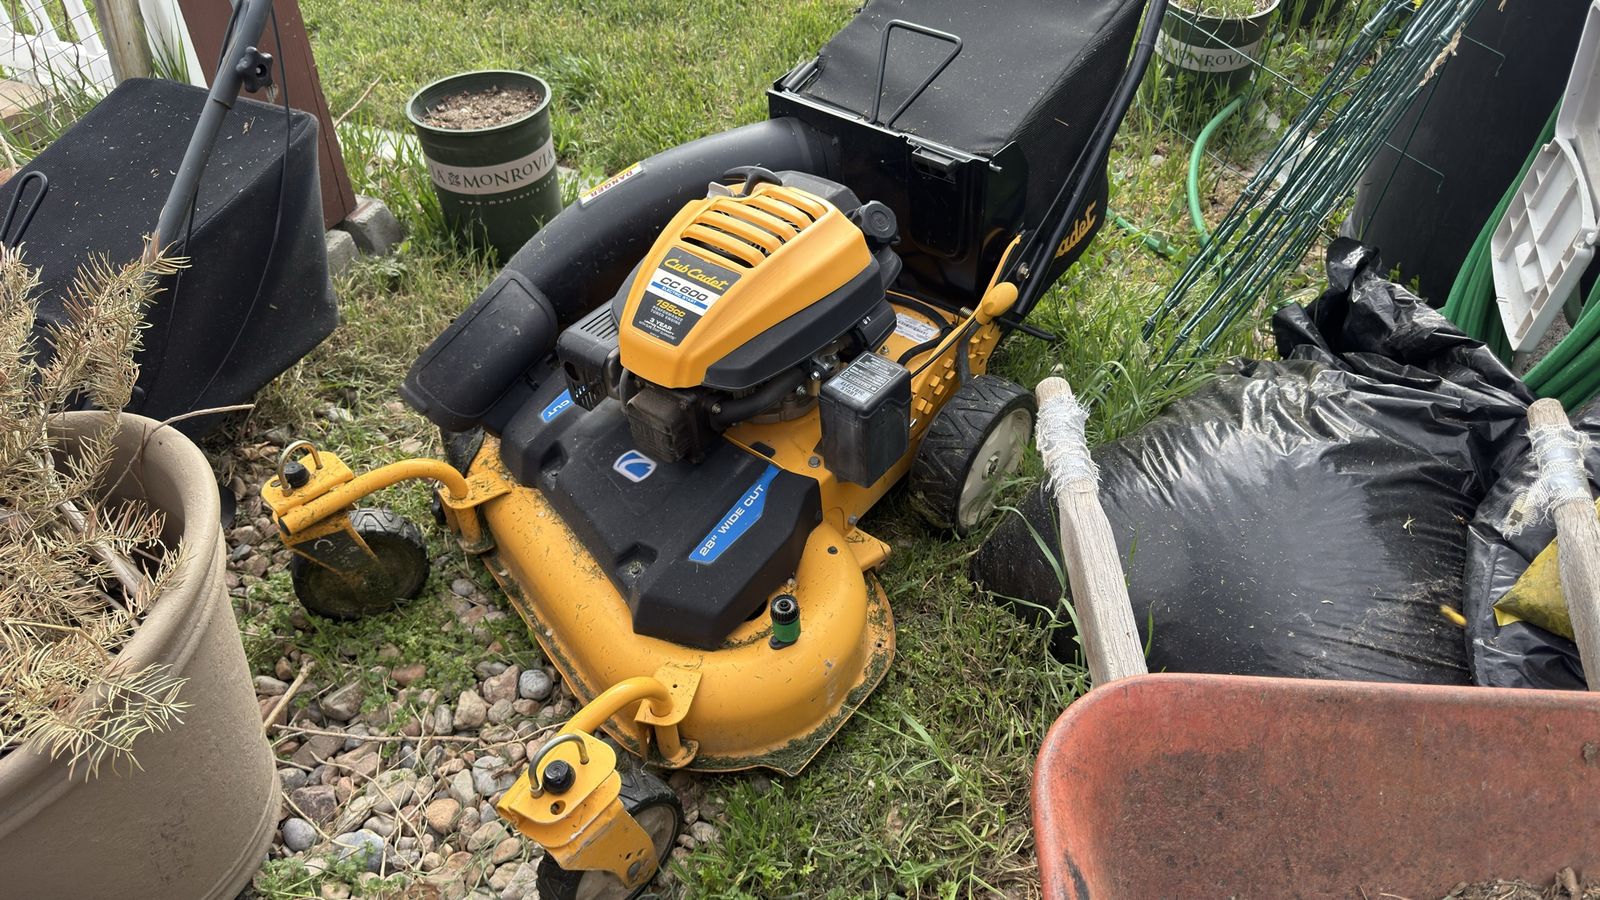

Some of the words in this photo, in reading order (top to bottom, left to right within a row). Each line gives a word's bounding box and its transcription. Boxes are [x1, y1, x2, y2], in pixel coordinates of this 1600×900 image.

[463, 149, 553, 189] MONROVIA
[591, 170, 633, 198] DANGER
[664, 258, 689, 276] Cub
[687, 268, 729, 291] Cadet
[660, 277, 681, 289] CC
[680, 285, 709, 302] 600
[661, 286, 682, 299] ELECTRIC
[681, 293, 697, 304] START
[656, 299, 686, 318] 195cc
[655, 319, 673, 331] YEAR
[840, 381, 866, 396] ELECTRIC
[840, 386, 858, 397] START
[548, 400, 570, 417] CUT
[718, 507, 745, 534] WIDE
[743, 484, 764, 507] CUT
